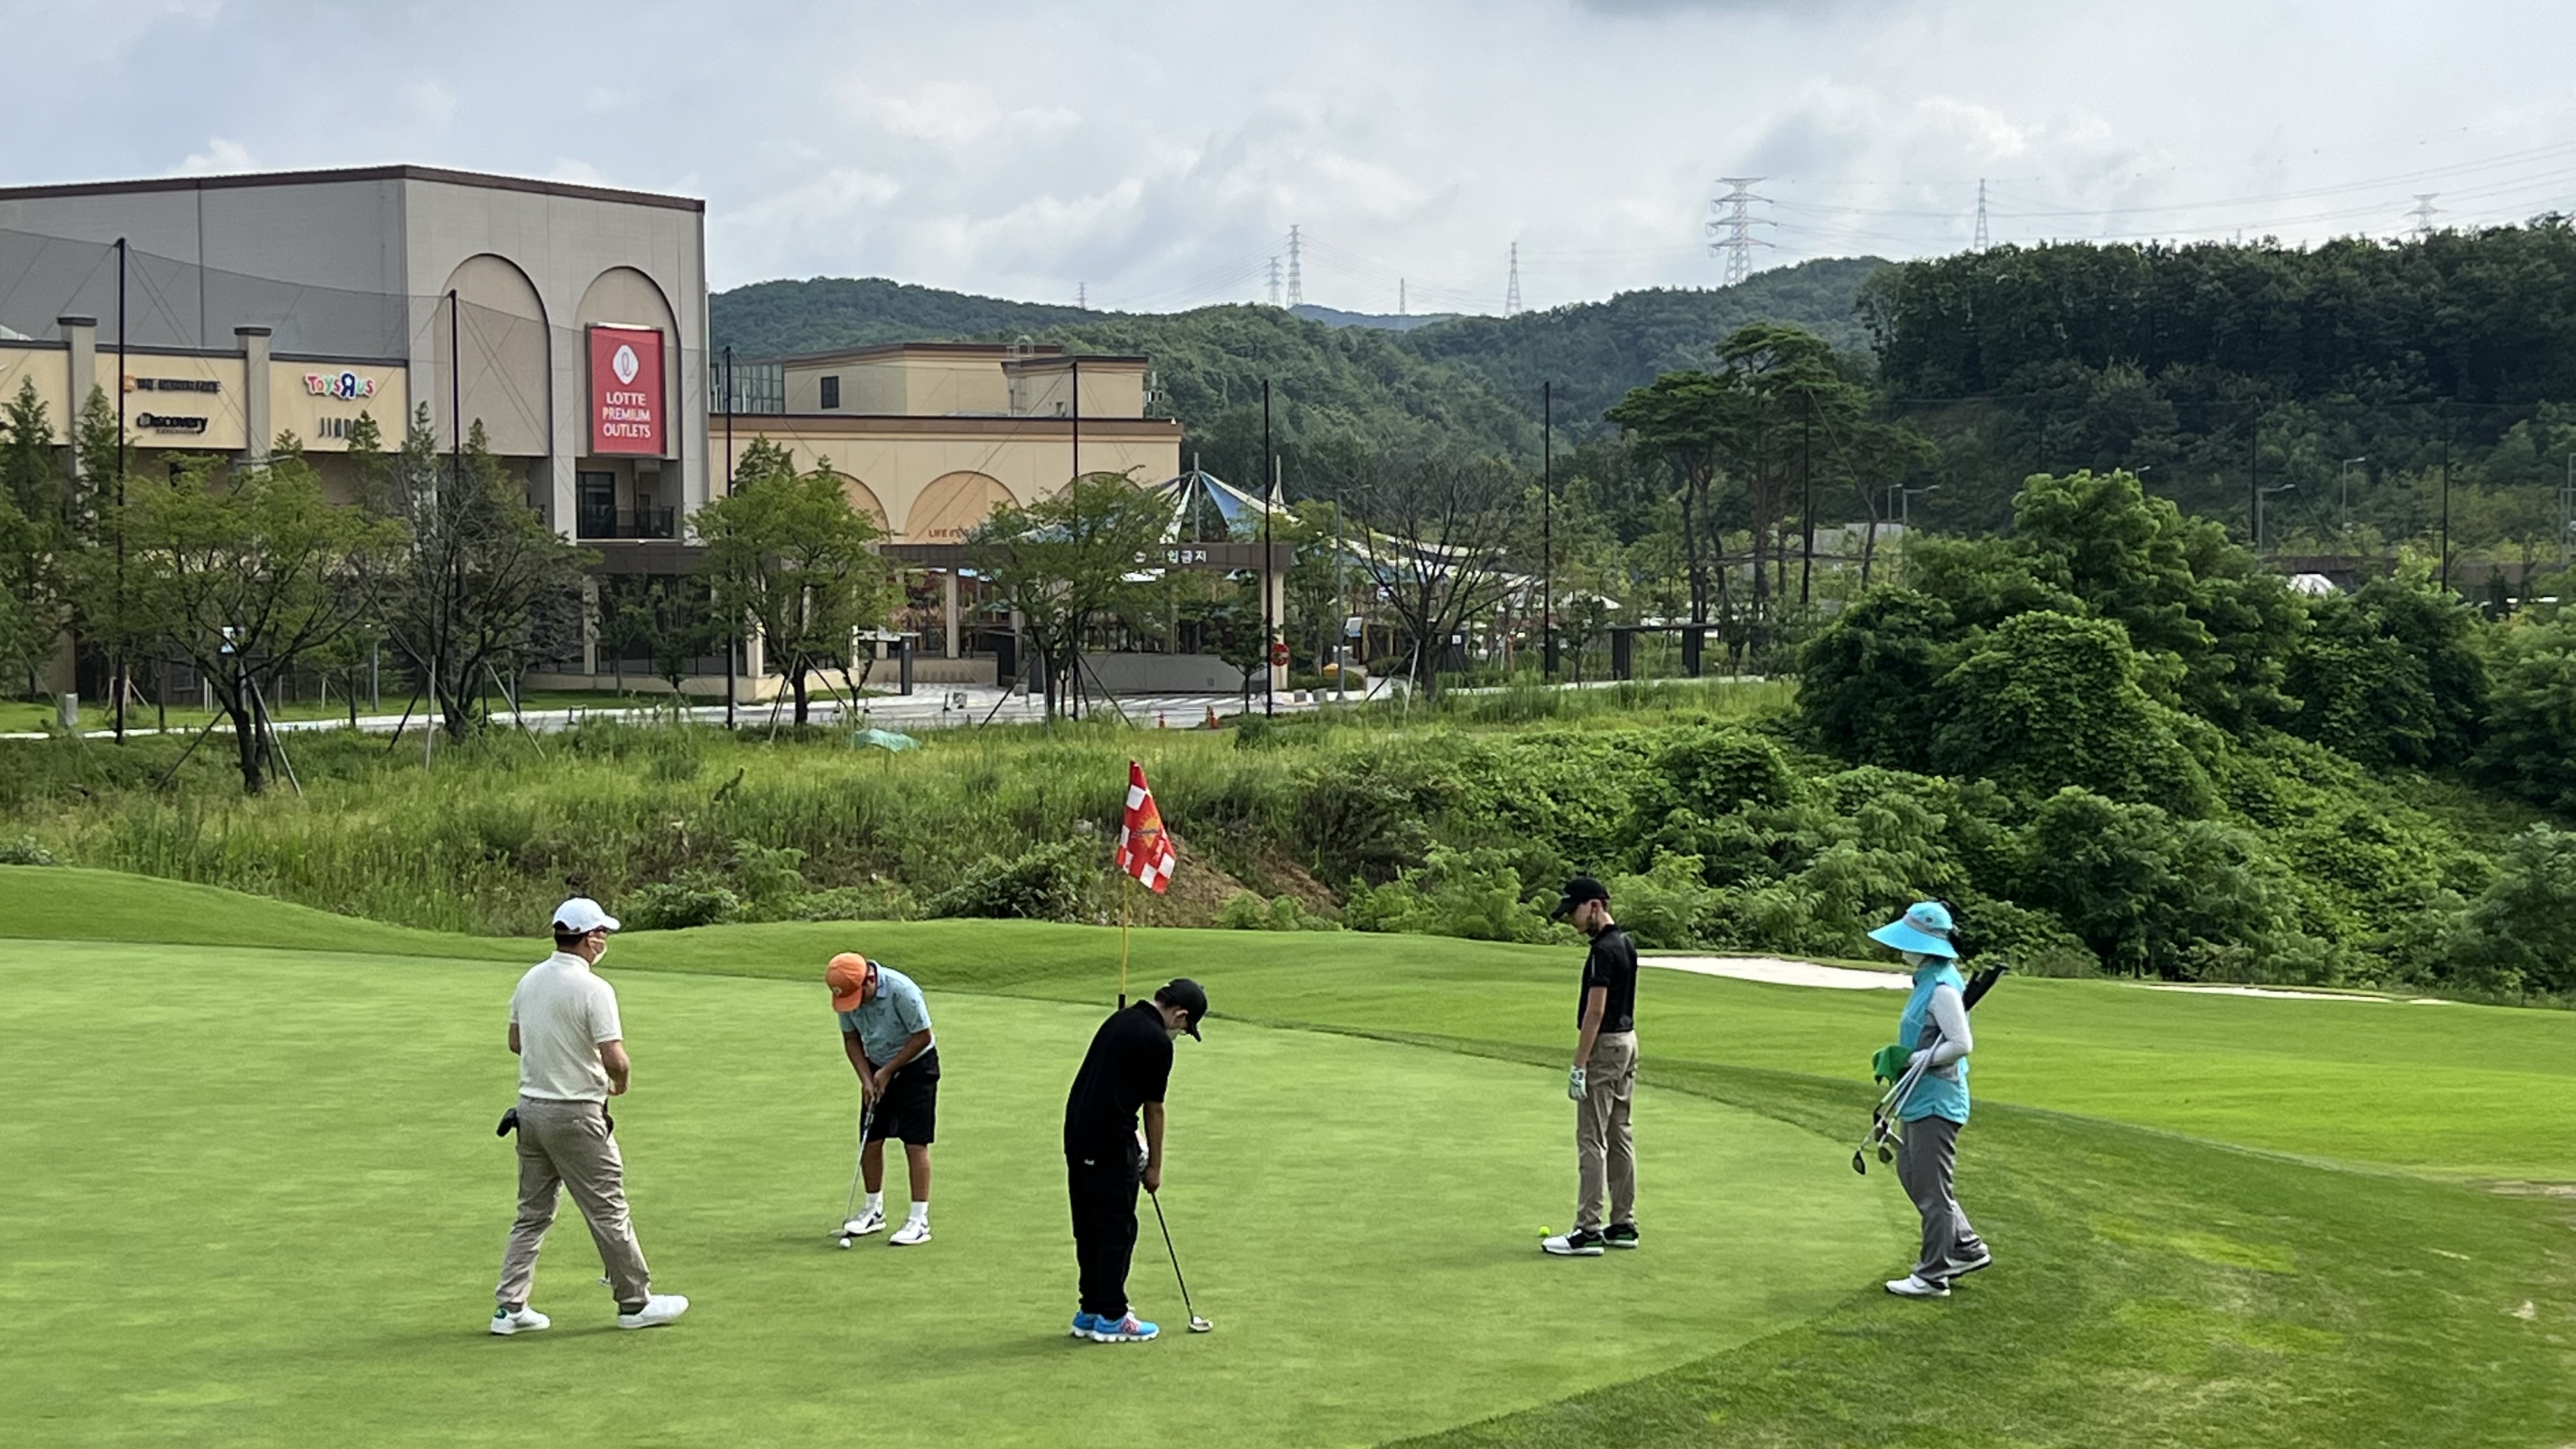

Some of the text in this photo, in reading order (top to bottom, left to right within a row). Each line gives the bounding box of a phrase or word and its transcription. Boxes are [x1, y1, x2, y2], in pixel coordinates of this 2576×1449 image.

[606, 391, 646, 406] LOTTE
[602, 406, 650, 421] PREMIUM
[603, 423, 650, 438] OUTLETS
